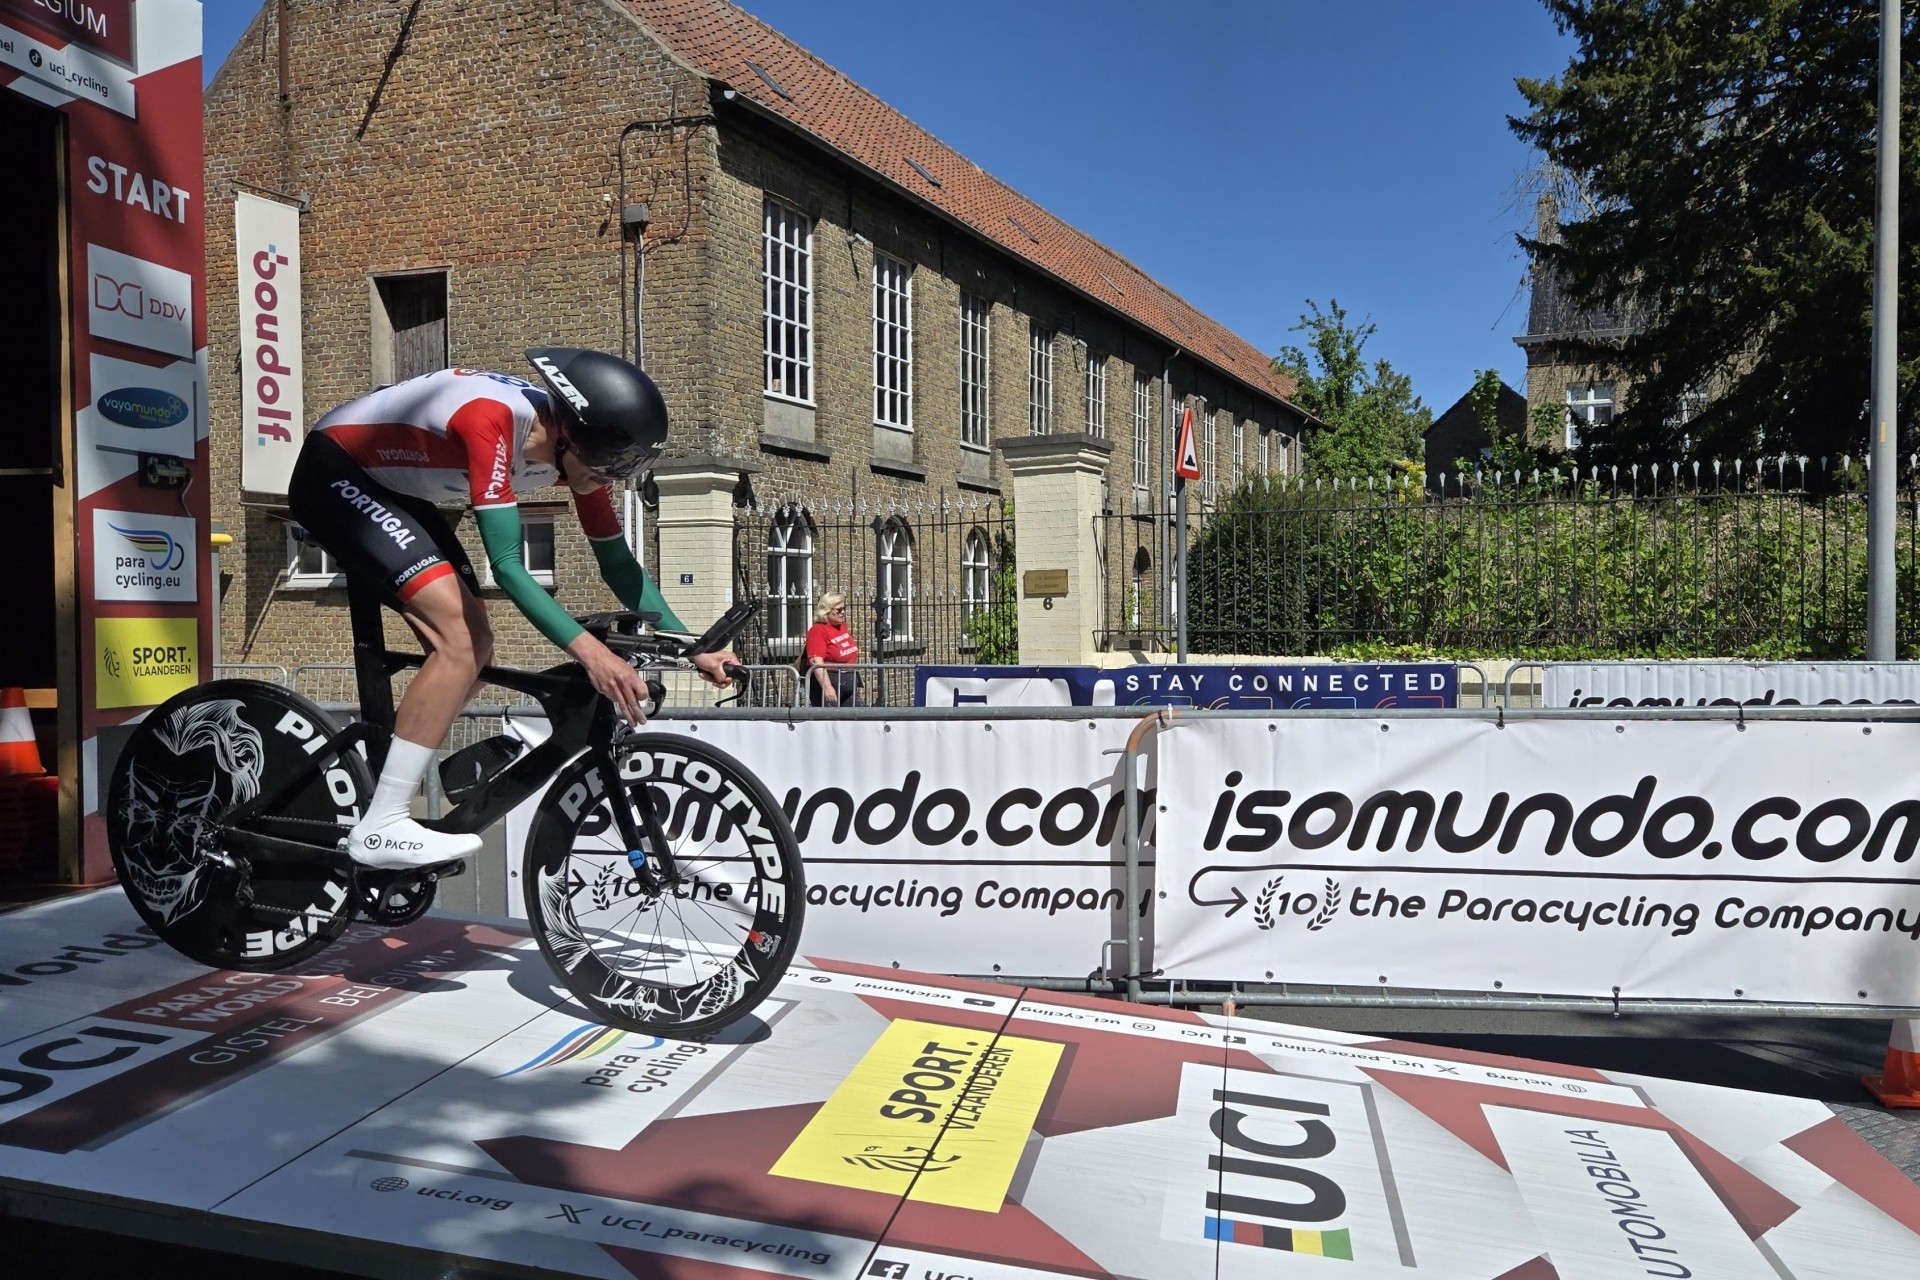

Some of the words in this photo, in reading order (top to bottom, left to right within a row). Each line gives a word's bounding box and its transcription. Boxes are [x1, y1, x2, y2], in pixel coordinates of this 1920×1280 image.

[49, 62, 108, 97] uci_cycling
[87, 156, 190, 224] START
[149, 298, 187, 321] DDV
[533, 356, 590, 411] LAZER
[104, 398, 171, 418] vayamundo
[377, 448, 430, 463] PORTUGAL
[331, 479, 416, 550] PORTUGAL
[115, 555, 145, 570] para
[394, 554, 440, 586] PORTUGAL
[115, 572, 180, 589] cycling.eu
[1043, 597, 1053, 610] 6
[132, 646, 192, 665] SPORT.
[132, 664, 191, 677] VLAANDEREN
[1126, 674, 1204, 692] STAY
[1229, 673, 1446, 692] CONNECTED
[384, 839, 424, 851] PACTO
[1278, 891, 1318, 916] 10
[1349, 886, 1426, 918] the
[1437, 889, 1700, 937] Paracycling
[1714, 897, 1920, 941] Company
[133, 986, 238, 1018] PARA
[178, 980, 304, 1023] WORLD
[856, 981, 952, 1000] ucichannel
[1020, 1006, 1121, 1026] uci_cycling
[189, 1015, 325, 1065] GISTEL
[1271, 1041, 1424, 1069] UCI_paracycling
[580, 1054, 641, 1088] para
[879, 1040, 979, 1124] SPORT.
[1486, 1071, 1553, 1088] uci.org
[940, 1044, 1014, 1130] VLAANDEREN
[1205, 1088, 1347, 1222] UCI
[416, 1185, 515, 1211] uci.org
[601, 1215, 831, 1265] UCI_paracycling
